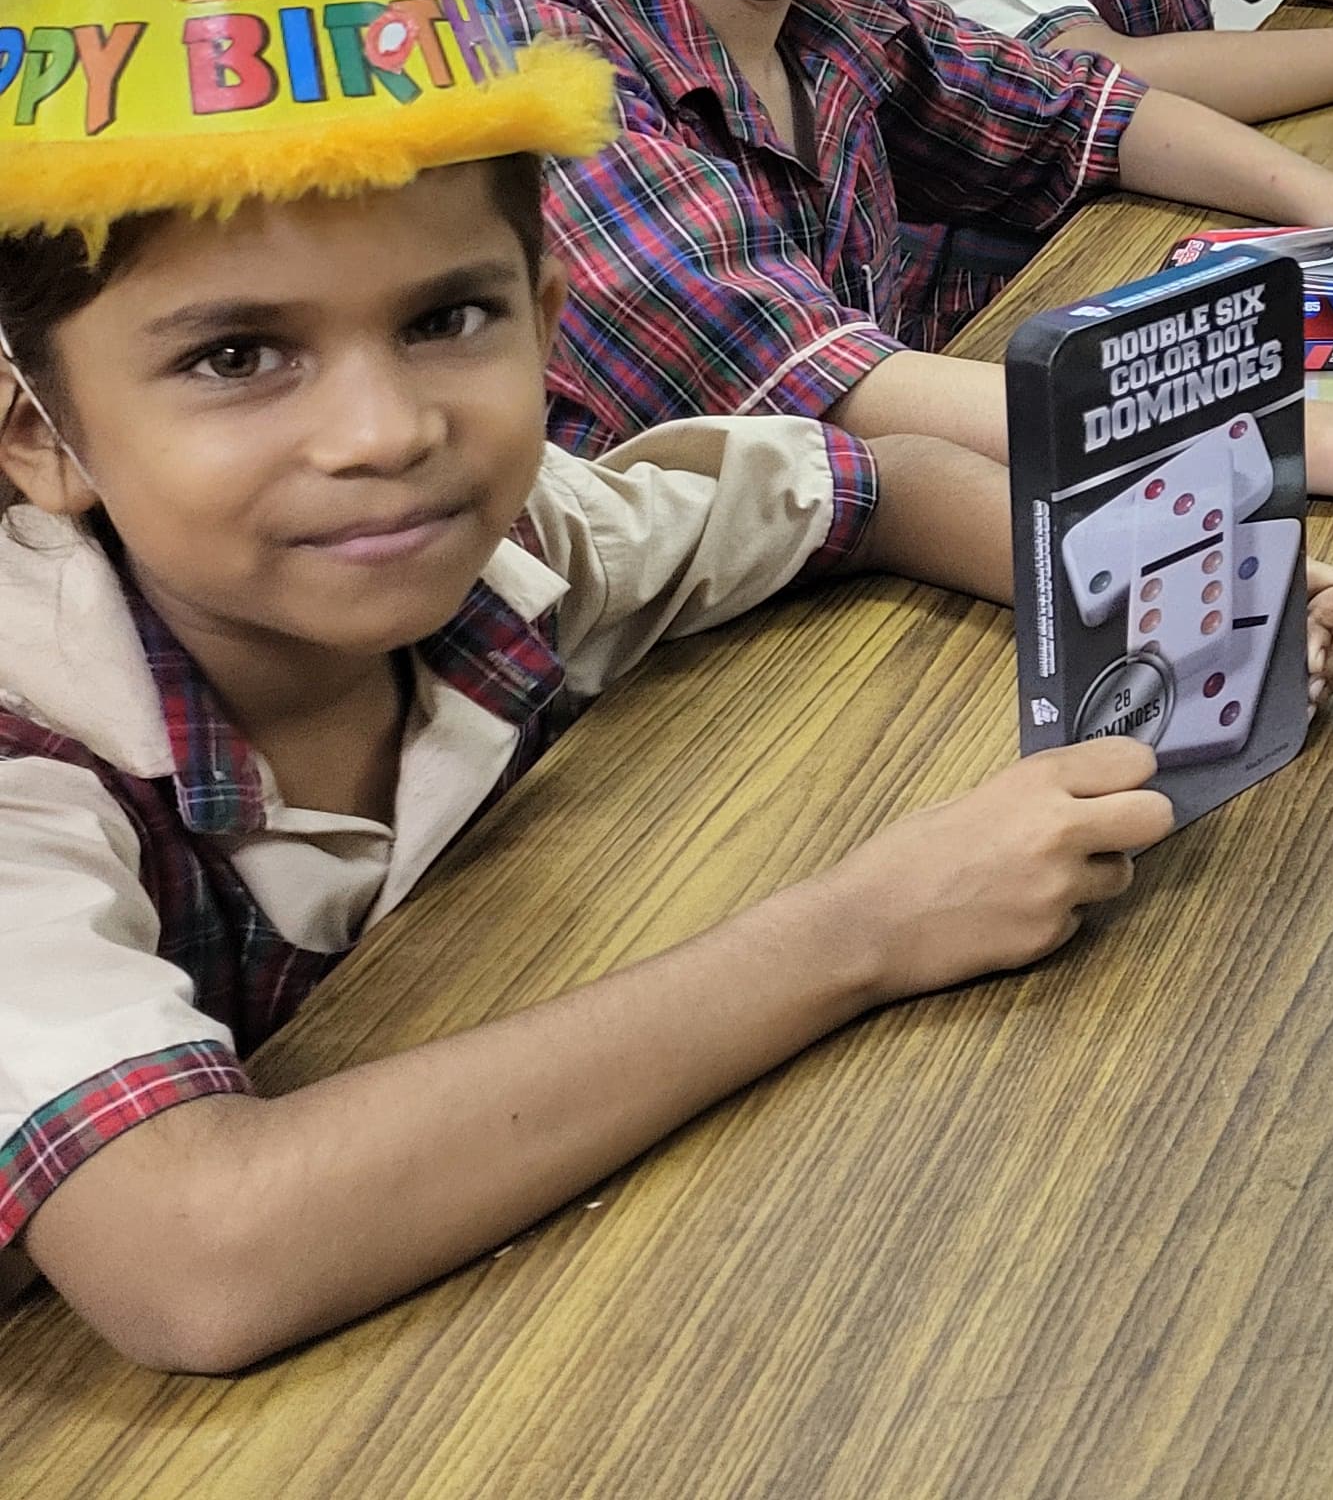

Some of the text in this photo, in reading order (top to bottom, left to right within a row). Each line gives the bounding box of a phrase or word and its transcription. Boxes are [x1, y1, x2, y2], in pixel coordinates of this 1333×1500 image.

[1101, 283, 1267, 370] DOUBLE SIX
[1110, 315, 1259, 398] COLOR DOT
[1083, 338, 1283, 454] DOMINOES
[1114, 687, 1131, 713] 28
